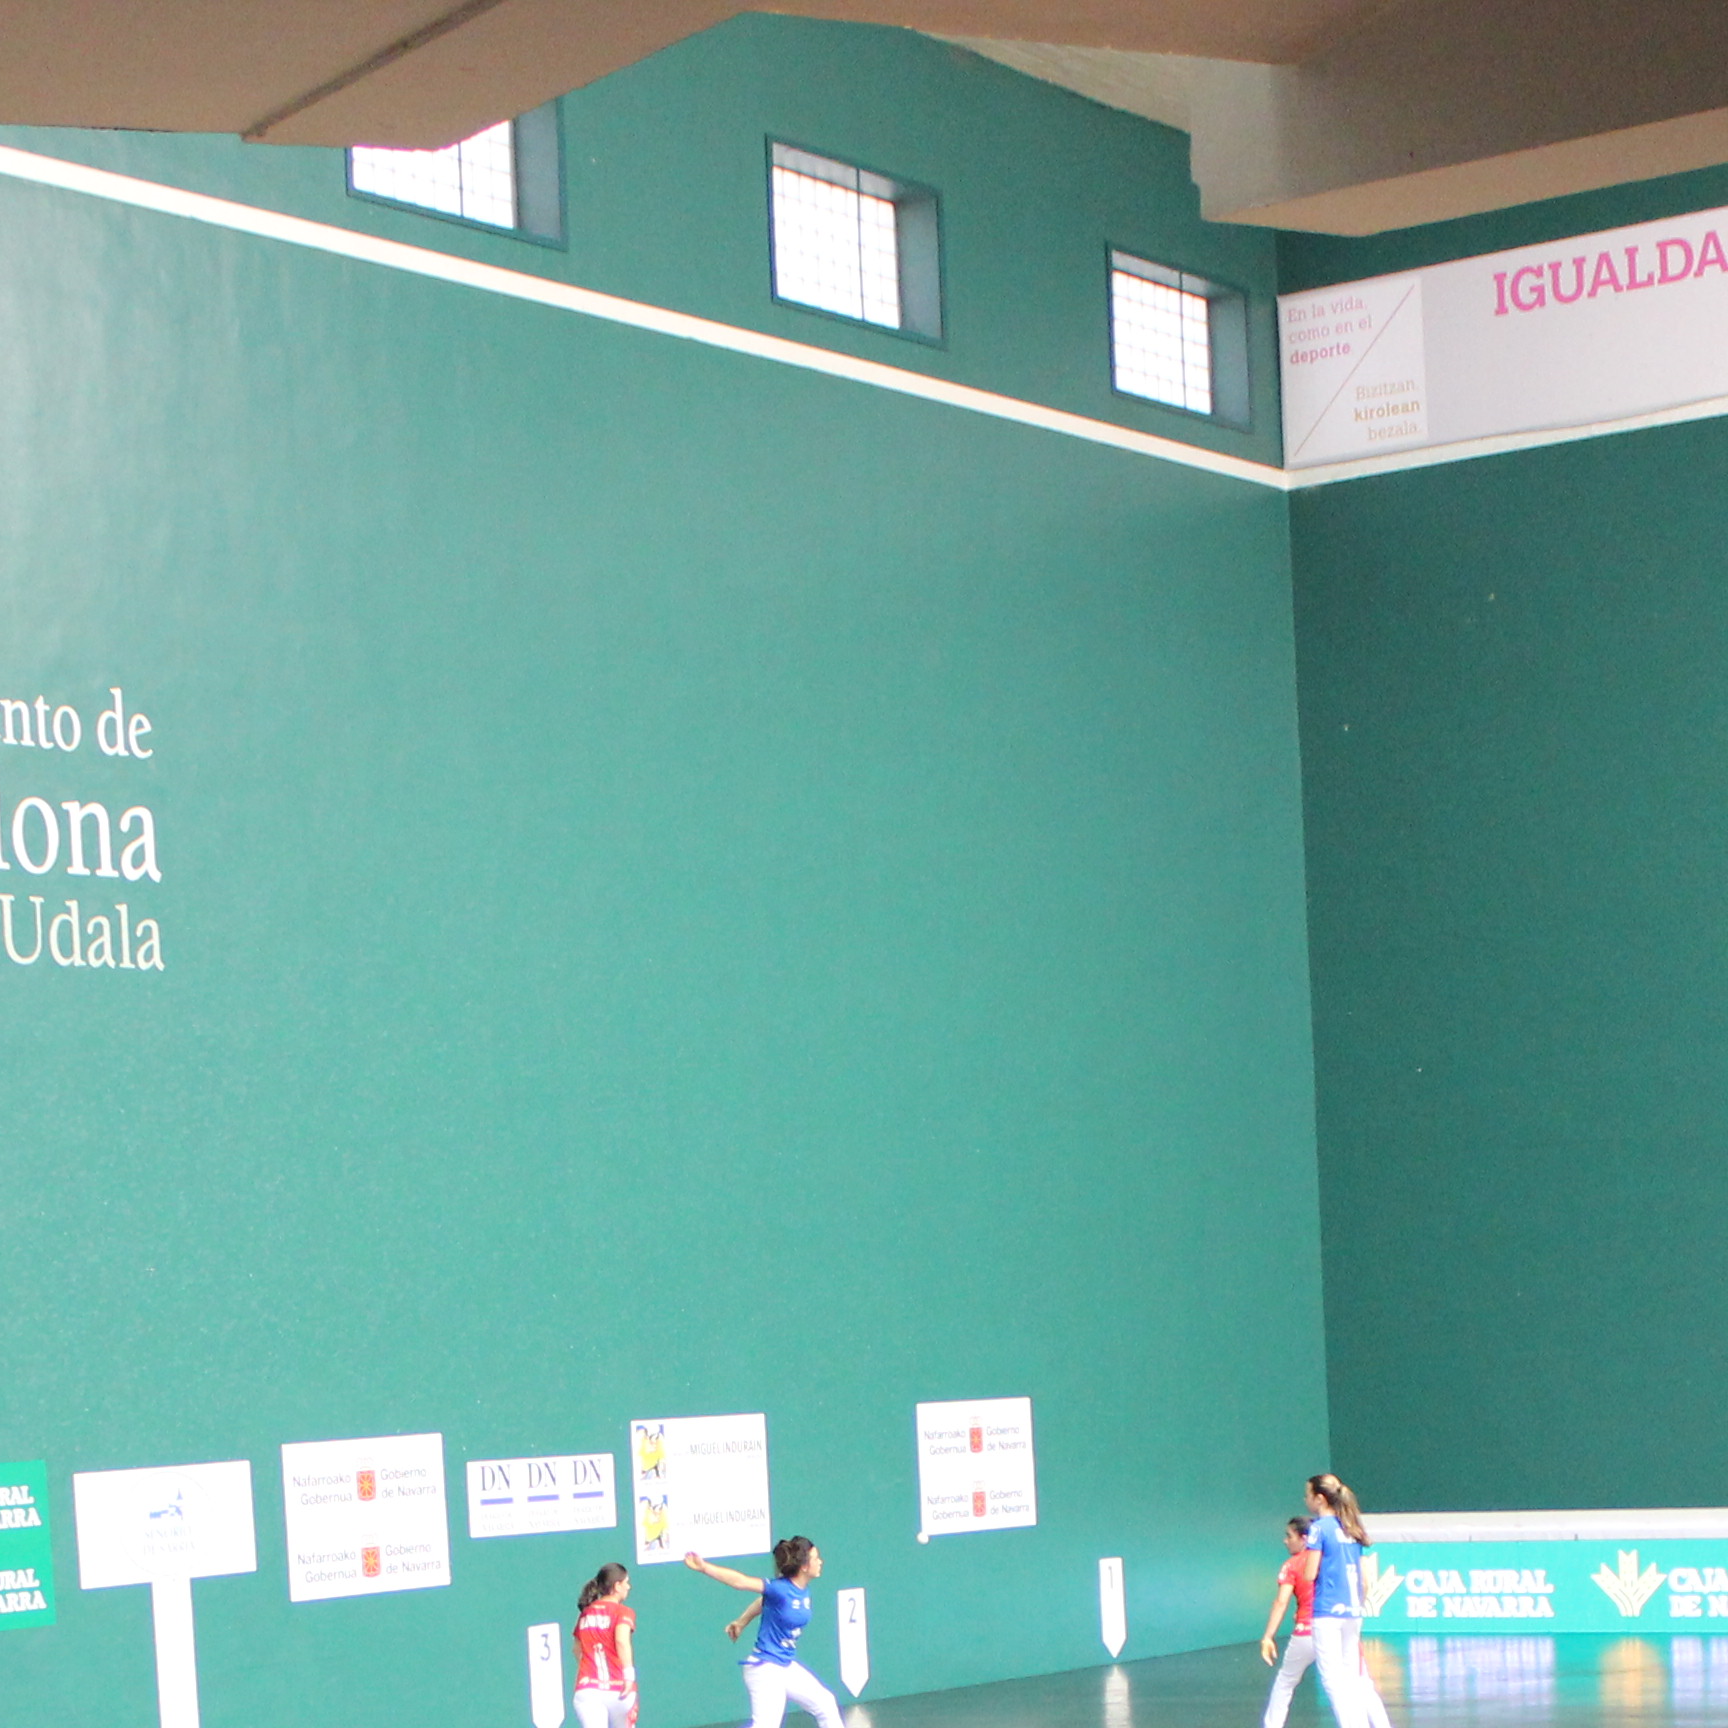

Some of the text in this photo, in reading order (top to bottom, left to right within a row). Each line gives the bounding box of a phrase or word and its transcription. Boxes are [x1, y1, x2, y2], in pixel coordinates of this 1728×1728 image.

[1287, 308, 1306, 323] En
[1312, 303, 1325, 318] la
[1288, 314, 1373, 344] como en el
[1289, 342, 1351, 364] deporte
[1354, 400, 1421, 422] kirolean
[97, 687, 154, 760] de
[689, 1441, 721, 1456] MIGUEL
[292, 1472, 352, 1489] Nafarroako
[380, 1467, 428, 1482] Gobierno
[480, 1463, 511, 1491] DN
[527, 1461, 557, 1489] DN
[572, 1458, 602, 1486] DN
[300, 1491, 353, 1506] Gobernua
[381, 1484, 437, 1499] de Navarra
[693, 1511, 724, 1526] MIGUEL
[297, 1549, 357, 1566] Nafarroako
[385, 1542, 432, 1557] Gobierno
[305, 1568, 358, 1584] Gobernua
[385, 1559, 442, 1575] de Navarra
[1107, 1564, 1115, 1591] 1
[1405, 1568, 1554, 1595] CAJA RURAL
[848, 1596, 857, 1624] 2
[1406, 1596, 1554, 1619] DE NAVARRA
[1669, 1594, 1702, 1618] DE
[539, 1632, 552, 1662] 3
